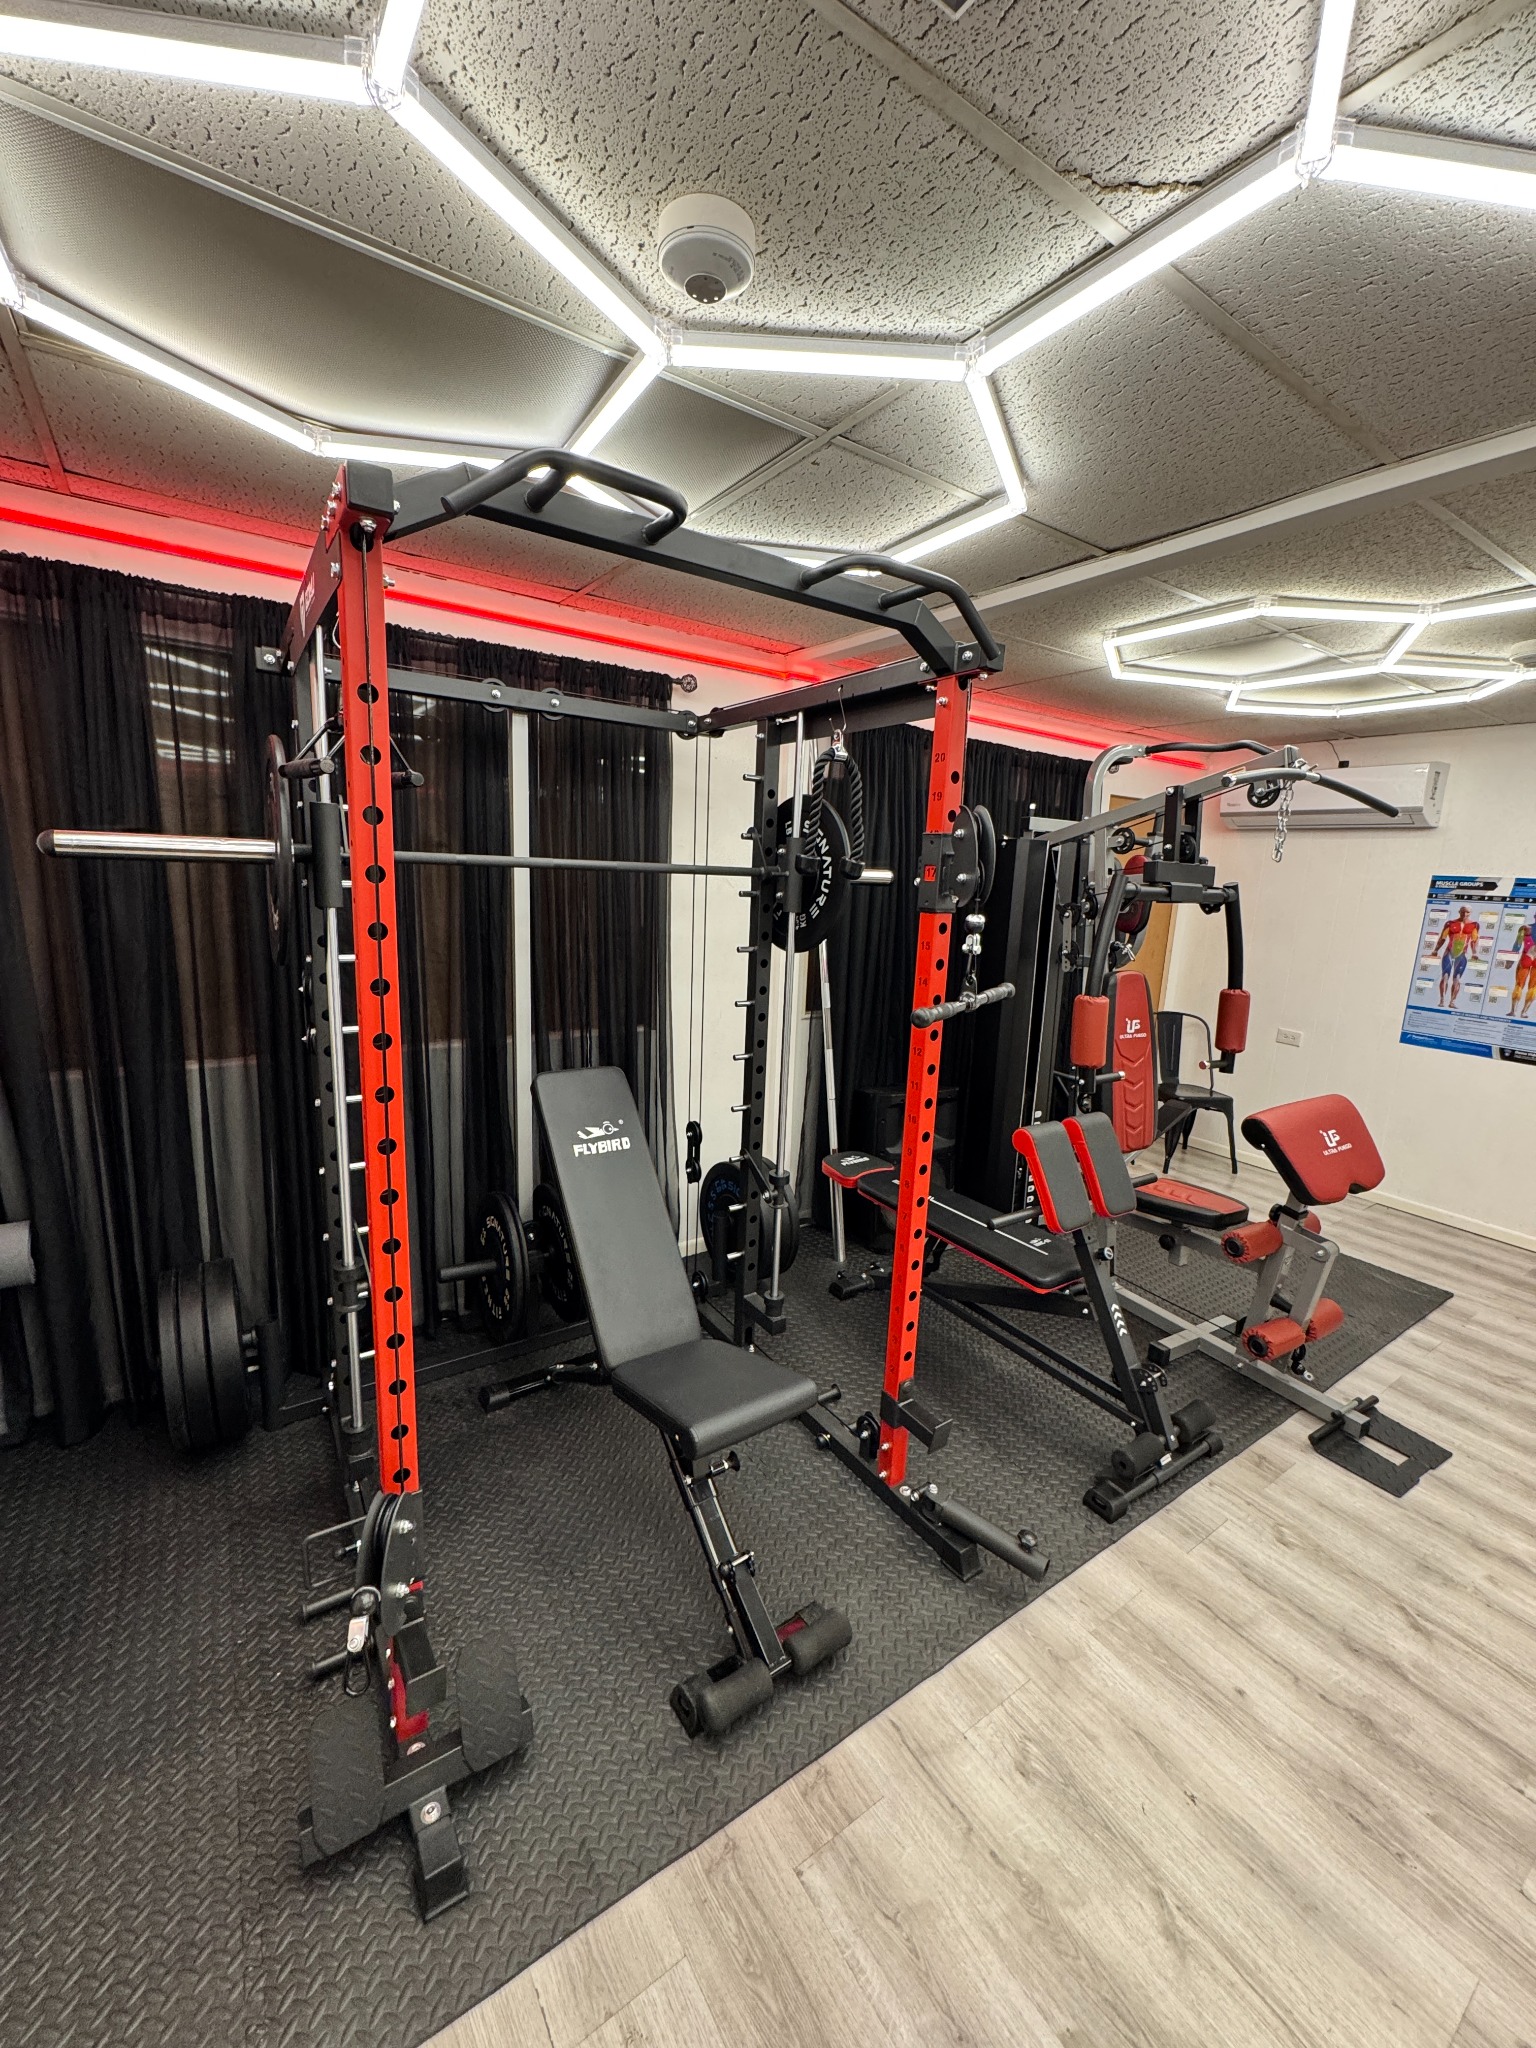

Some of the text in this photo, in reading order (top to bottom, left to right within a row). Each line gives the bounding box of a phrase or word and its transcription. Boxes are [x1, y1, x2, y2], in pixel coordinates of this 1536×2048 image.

[934, 753, 946, 763] 20
[932, 792, 943, 801] 19
[804, 820, 832, 919] SGNATURE
[926, 867, 936, 878] 17
[920, 941, 931, 951] 15
[918, 977, 928, 987] 14
[912, 1047, 922, 1057] 12
[910, 1081, 919, 1091] 11
[572, 1136, 631, 1158] FLYBIRD
